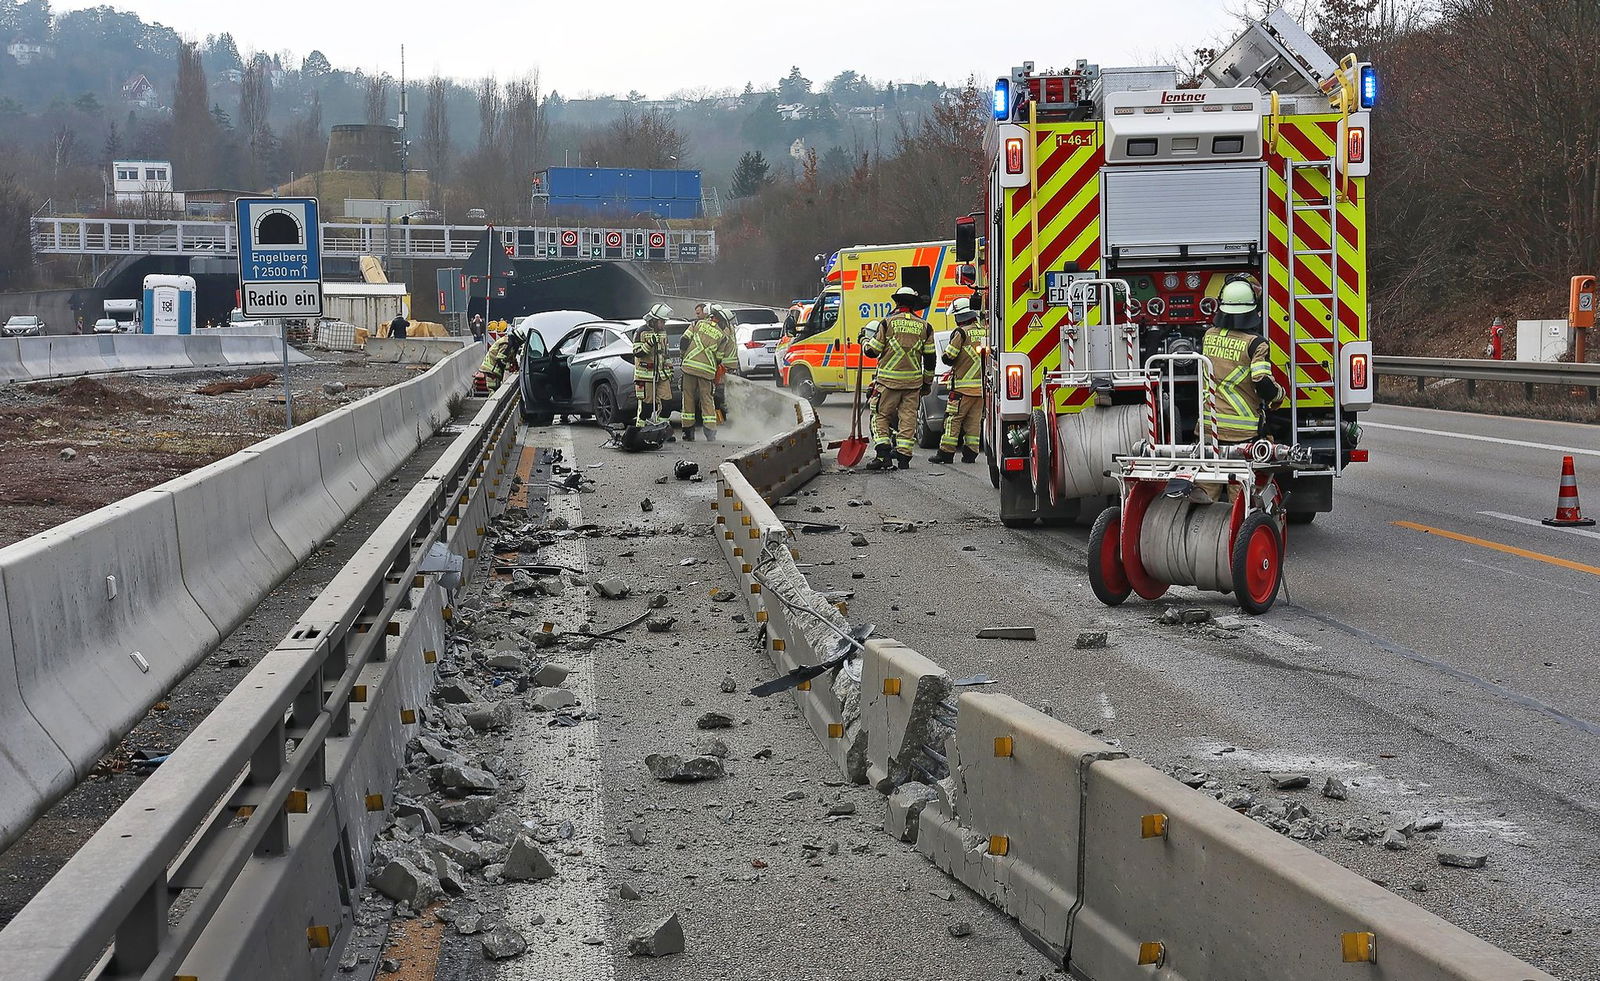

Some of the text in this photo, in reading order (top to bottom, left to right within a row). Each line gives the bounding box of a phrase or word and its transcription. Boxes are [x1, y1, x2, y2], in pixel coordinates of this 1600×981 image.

[1161, 91, 1206, 104] Lentner
[1057, 134, 1092, 146] 1-46-1
[252, 252, 308, 264] Engelberg
[261, 267, 287, 277] 2500
[870, 262, 898, 282] ASB
[249, 290, 316, 306] Radio ein
[873, 303, 892, 318] 112
